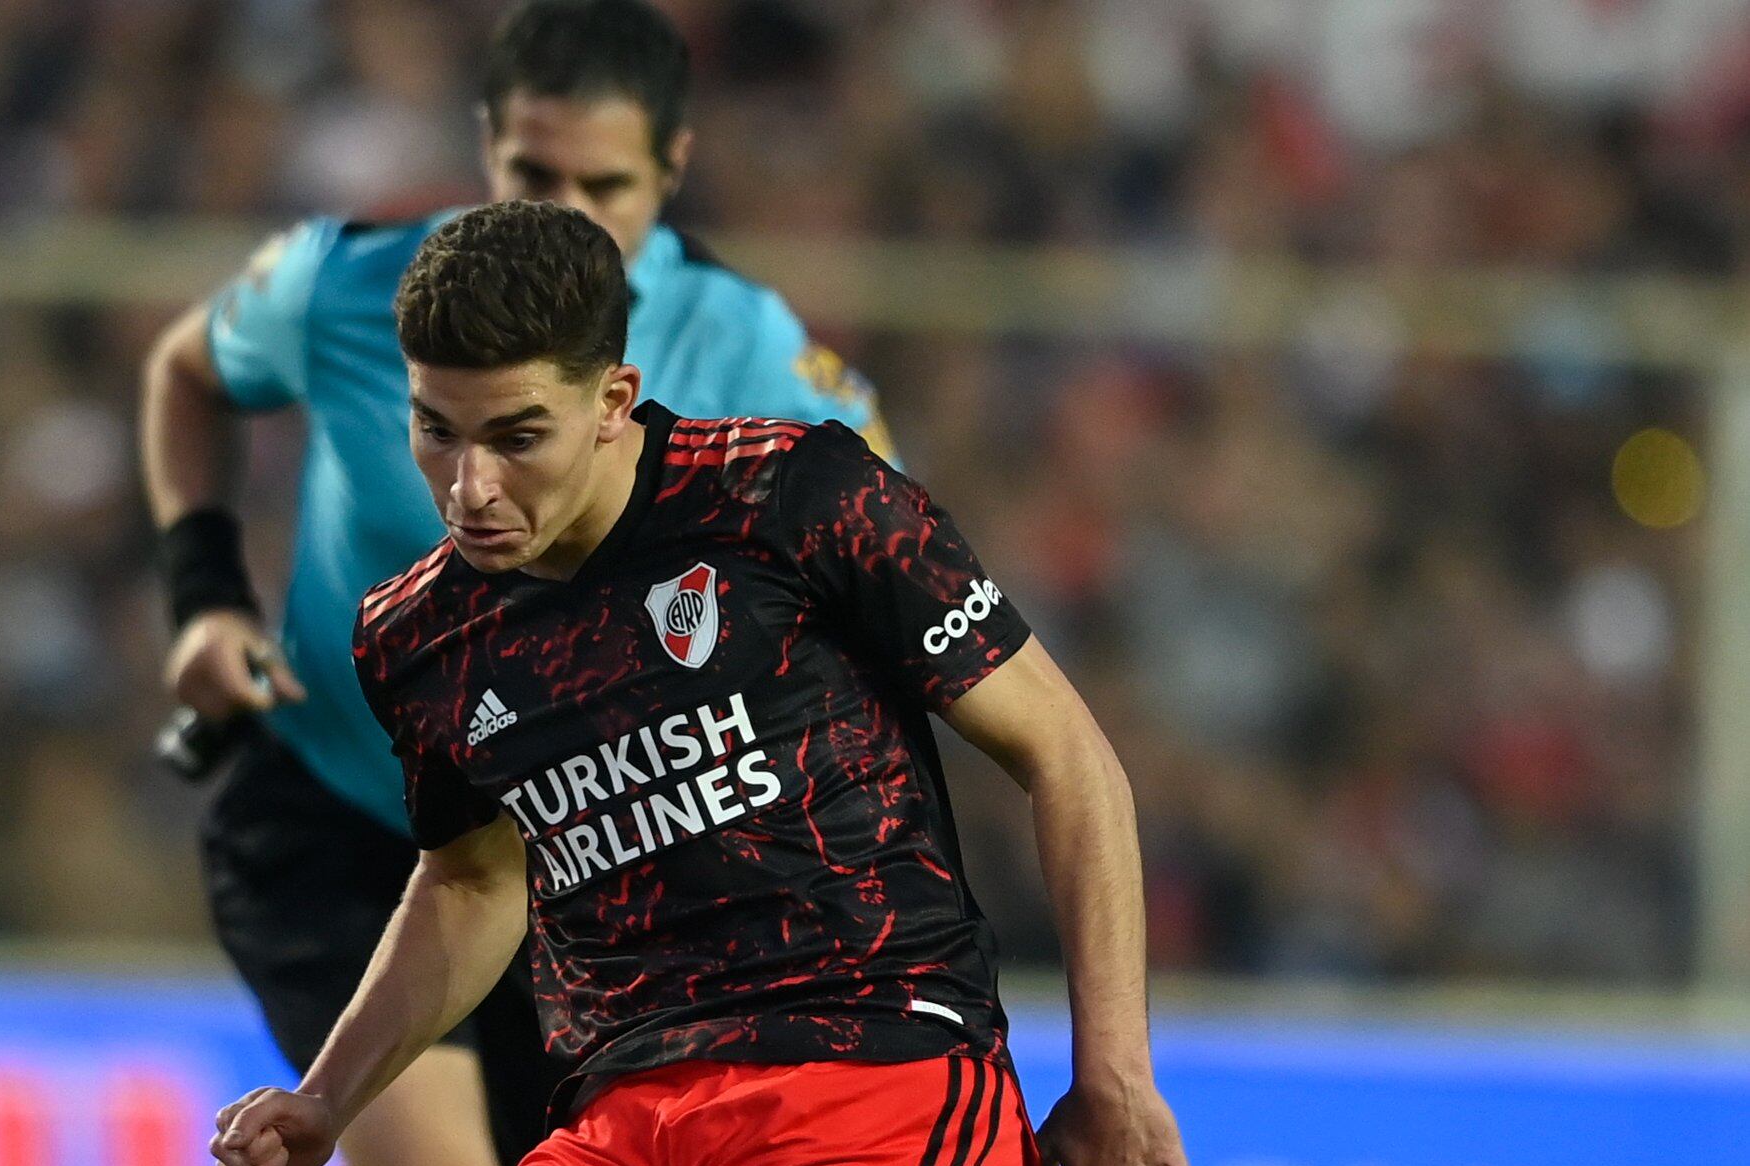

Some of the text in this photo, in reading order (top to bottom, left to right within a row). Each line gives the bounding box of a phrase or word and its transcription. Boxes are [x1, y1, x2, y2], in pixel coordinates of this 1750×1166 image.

[467, 709, 518, 747] adidas
[501, 692, 757, 837] TURKISH
[536, 750, 782, 891] AIRLINES
